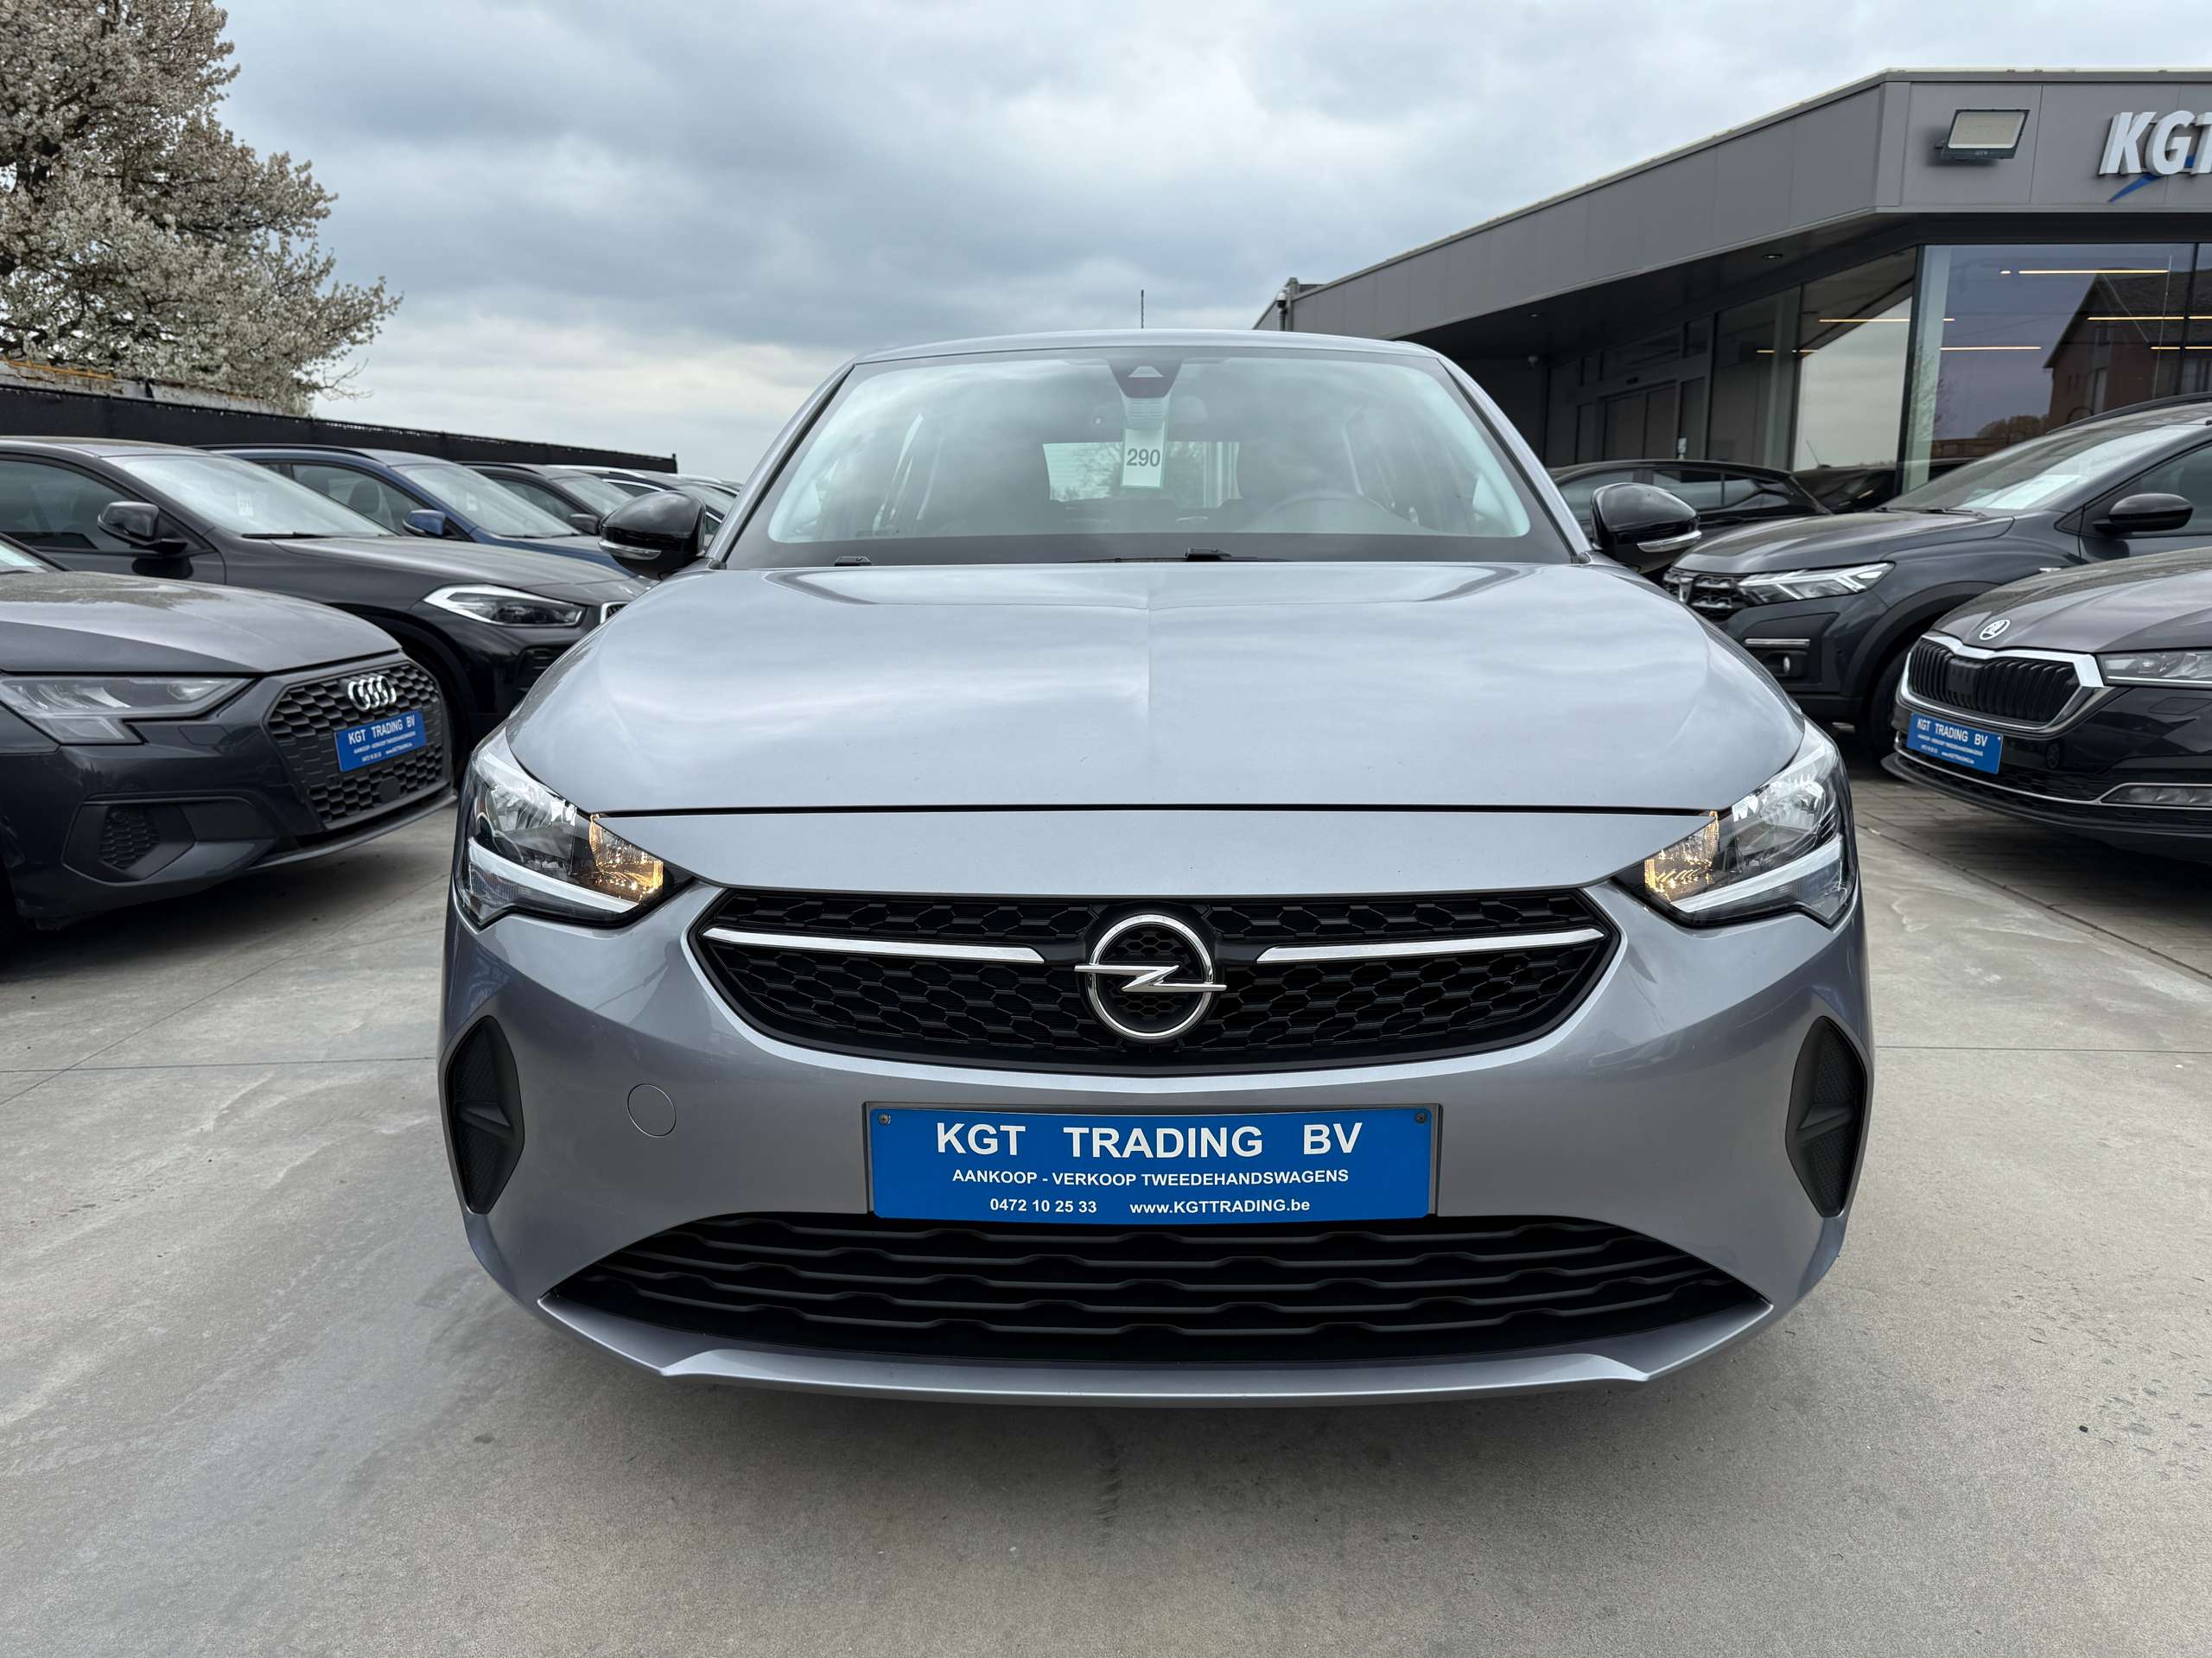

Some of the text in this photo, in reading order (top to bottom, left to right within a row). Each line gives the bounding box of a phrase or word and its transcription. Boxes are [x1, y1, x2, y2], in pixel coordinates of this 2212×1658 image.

[1126, 448, 1160, 467] 290
[347, 729, 365, 745] KGT
[371, 719, 404, 739] TRADING
[405, 715, 416, 728] BV
[1916, 718, 1931, 732] KGT
[1935, 723, 1968, 742] TRADING
[1974, 733, 1988, 746] BV
[937, 1122, 1363, 1159] KGT TRADING BV
[952, 1169, 1038, 1185] AANKOOP
[1052, 1172, 1137, 1186] VERKOOP
[1141, 1169, 1349, 1186] TWEEDEHANDSWAGENS
[989, 1197, 1097, 1213] 0472 10 25 33
[1129, 1198, 1310, 1214] www.KGTTRADING.be
